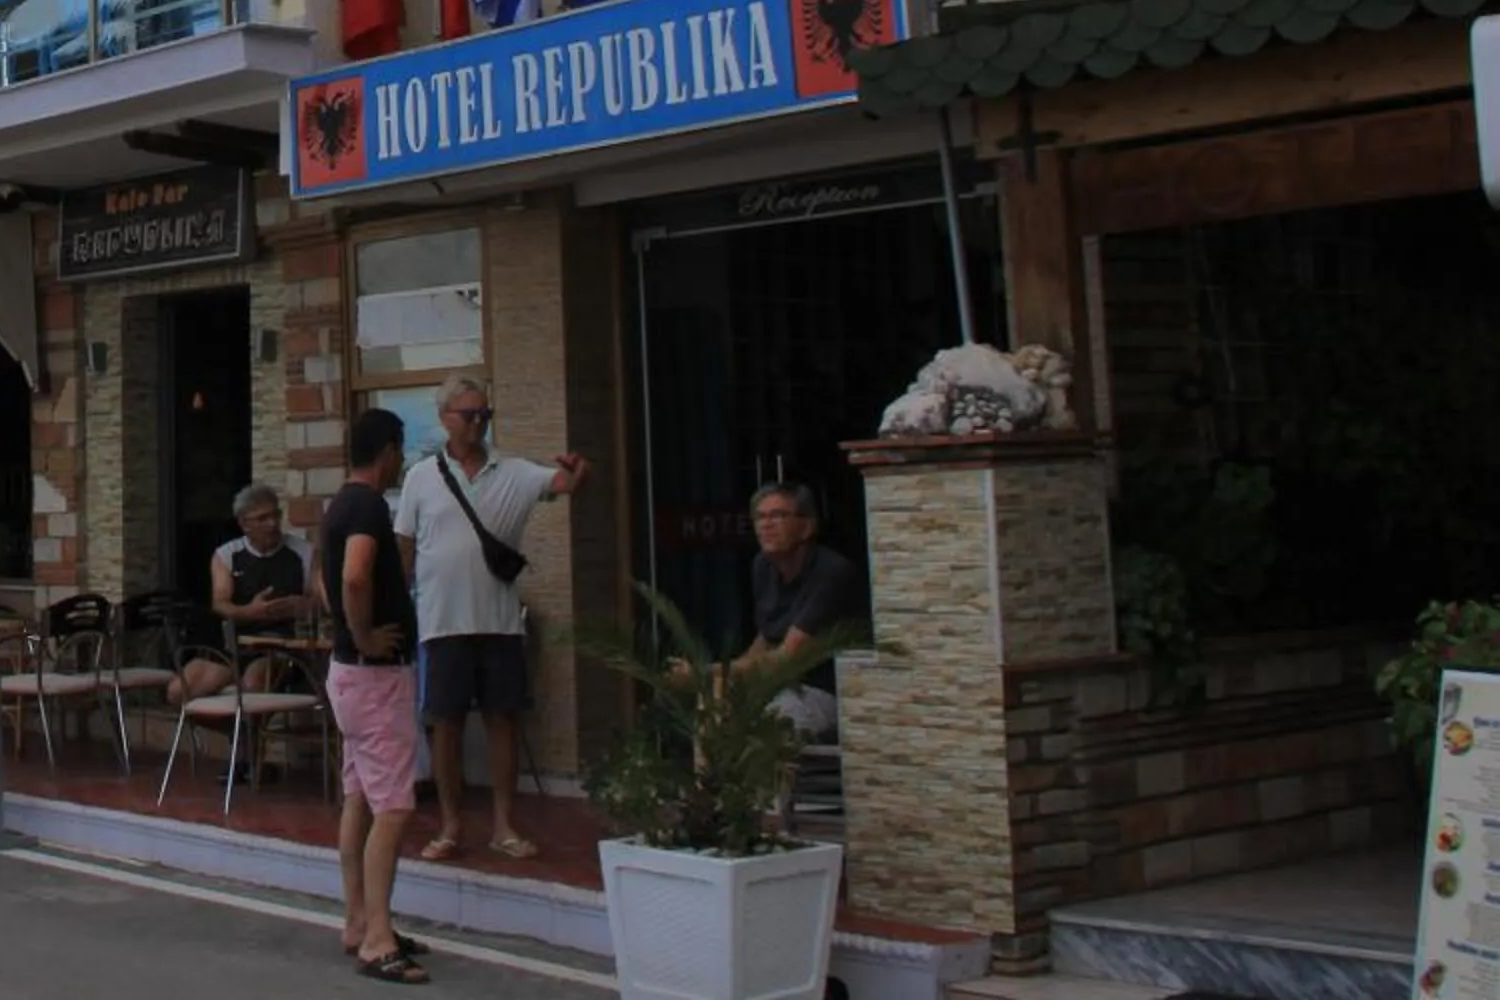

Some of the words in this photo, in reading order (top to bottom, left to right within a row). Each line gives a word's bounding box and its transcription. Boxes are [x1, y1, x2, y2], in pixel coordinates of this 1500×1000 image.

[374, 63, 502, 161] HOTEL
[513, 1, 778, 133] REPUBLIKA
[682, 513, 749, 538] HOTE
